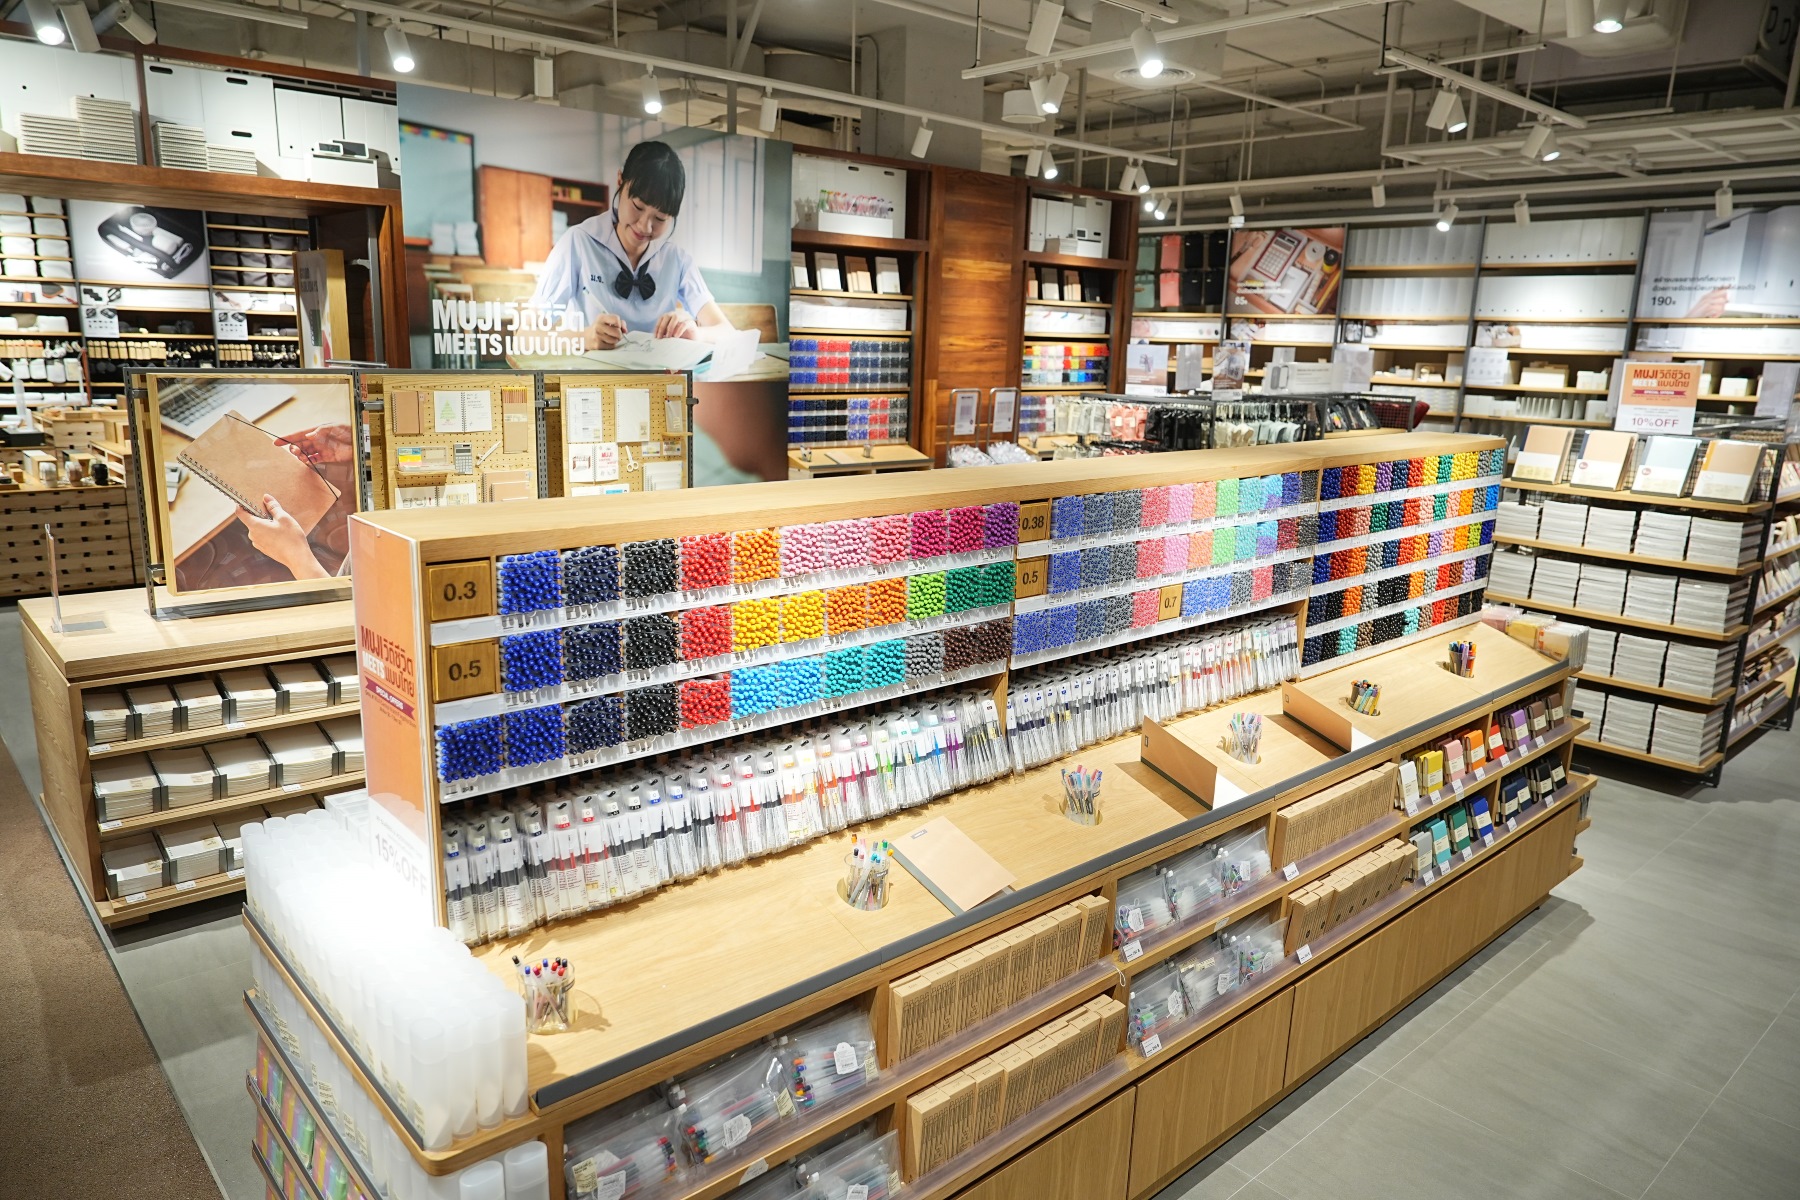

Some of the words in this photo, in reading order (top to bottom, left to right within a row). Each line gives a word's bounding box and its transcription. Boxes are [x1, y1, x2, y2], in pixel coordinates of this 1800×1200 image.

[432, 299, 502, 332] MUJI
[434, 332, 503, 356] MEETS
[505, 332, 585, 356] แบบไทย
[1633, 369, 1658, 379] MUJI
[1022, 515, 1044, 530] 0.38
[1022, 571, 1039, 584] 0.5
[443, 582, 477, 602] 0.3
[1164, 596, 1177, 609] 0.7
[360, 625, 383, 659] MUJI
[362, 650, 385, 680] MEETS
[385, 665, 415, 698] แบบไทย
[448, 659, 482, 682] 0.5
